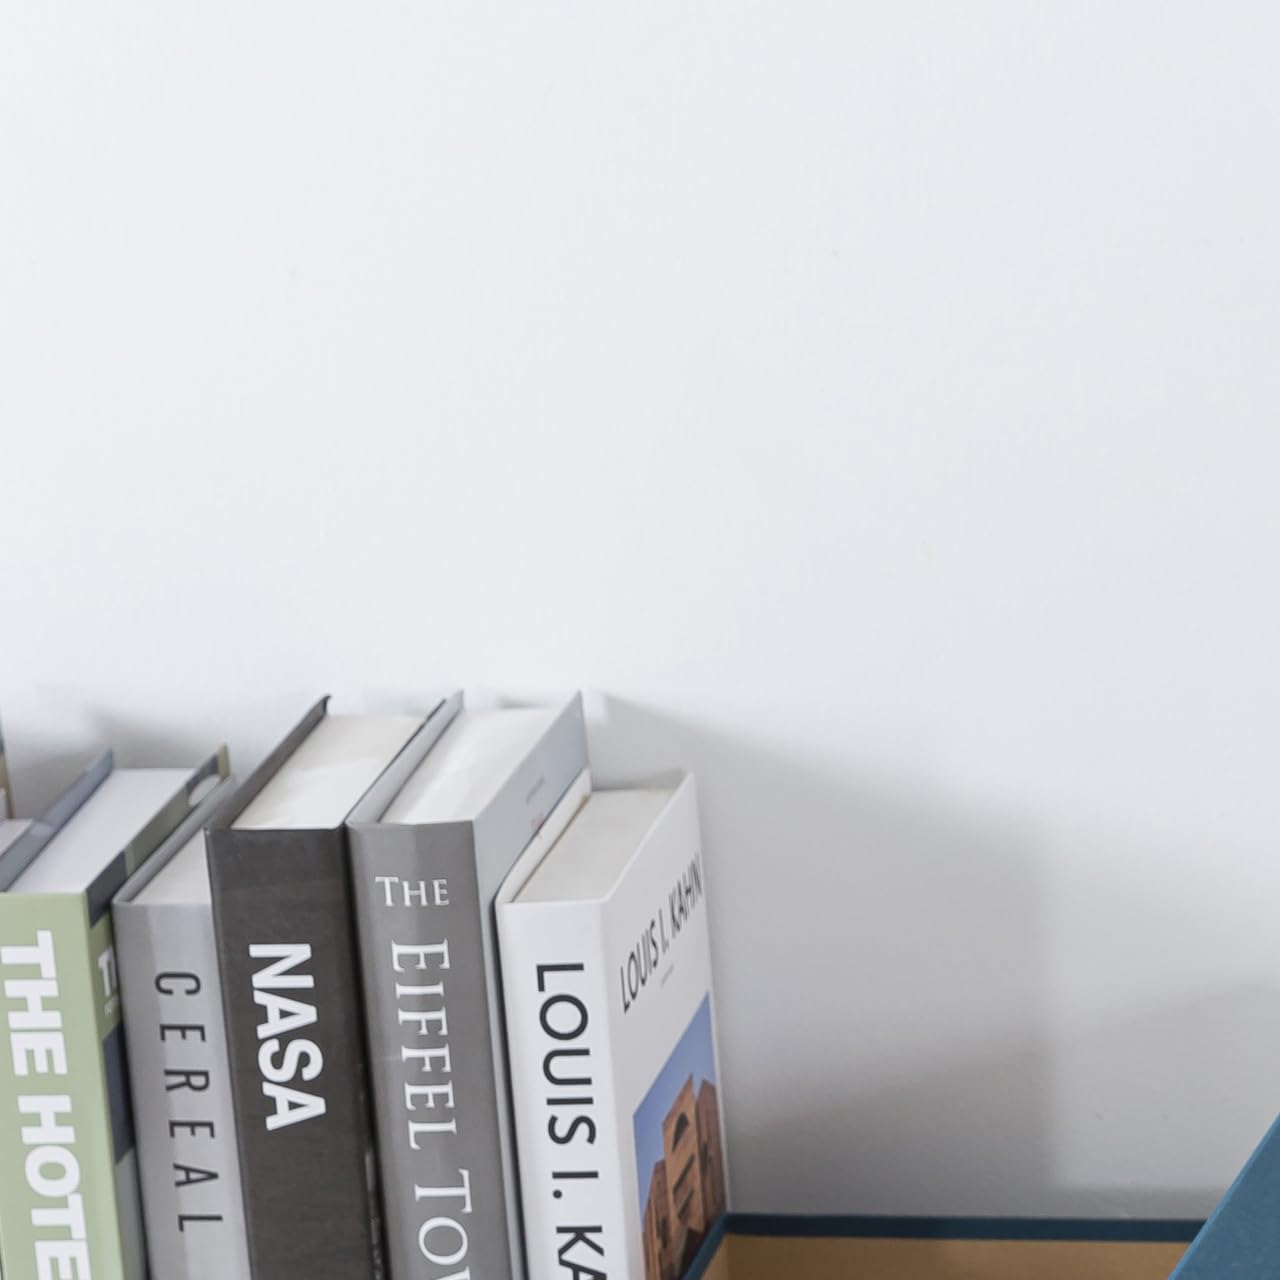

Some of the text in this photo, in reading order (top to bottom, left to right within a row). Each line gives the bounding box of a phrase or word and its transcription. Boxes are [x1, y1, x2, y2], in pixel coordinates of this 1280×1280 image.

[375, 876, 449, 907] THE
[620, 919, 659, 1014] LOUIS
[0, 930, 67, 1076] THE
[249, 943, 327, 1131] NASA
[391, 937, 457, 1150] EIFFEL
[536, 963, 597, 1145] LOUIS
[154, 972, 223, 1232] CEREAL
[552, 1171, 599, 1199] I.
